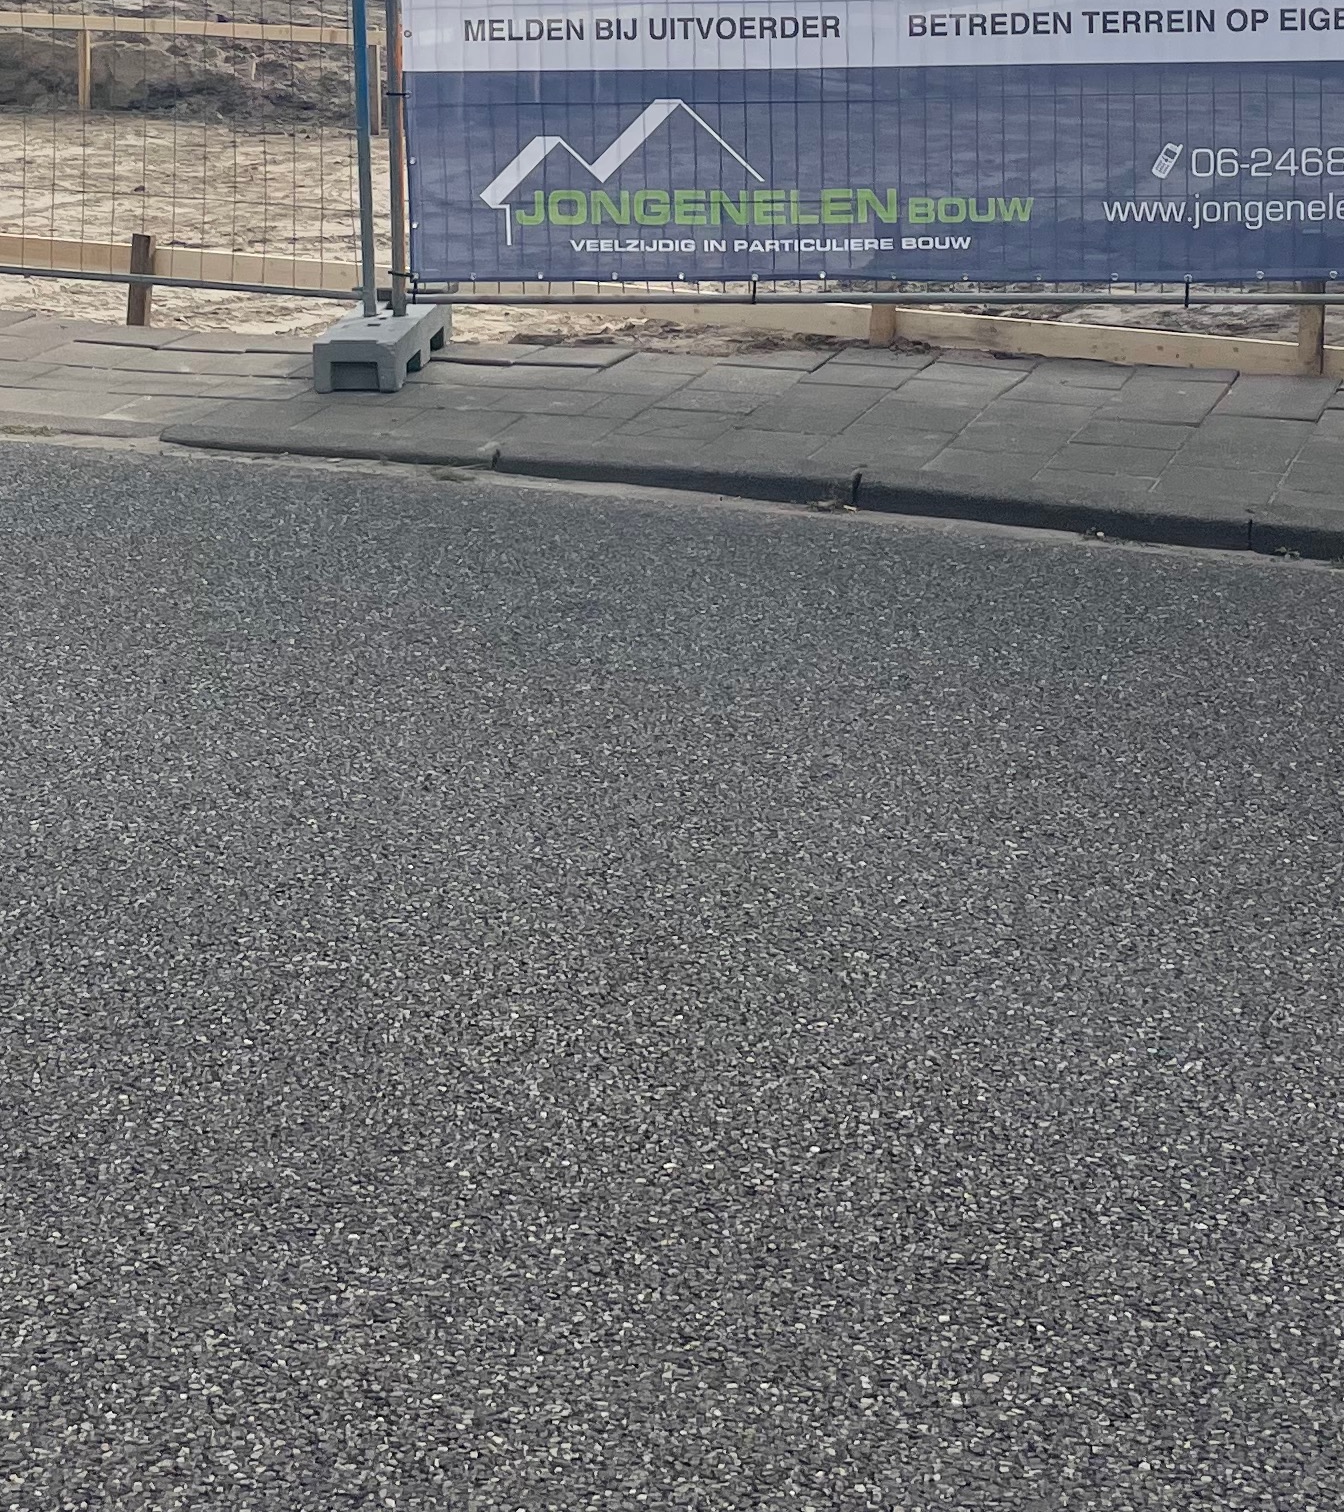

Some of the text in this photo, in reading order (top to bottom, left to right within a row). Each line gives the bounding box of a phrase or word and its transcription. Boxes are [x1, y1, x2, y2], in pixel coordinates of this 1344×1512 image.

[464, 16, 841, 42] MELDEN BIJ UITVOERDER
[908, 10, 1072, 38] BETREDEN
[1082, 9, 1213, 34] TERREIN
[1225, 8, 1269, 33] OP
[515, 188, 1035, 226] JONGENELEN BOUW
[569, 236, 973, 253] VEELZIJDIG IN PARTICULIERE BOUW
